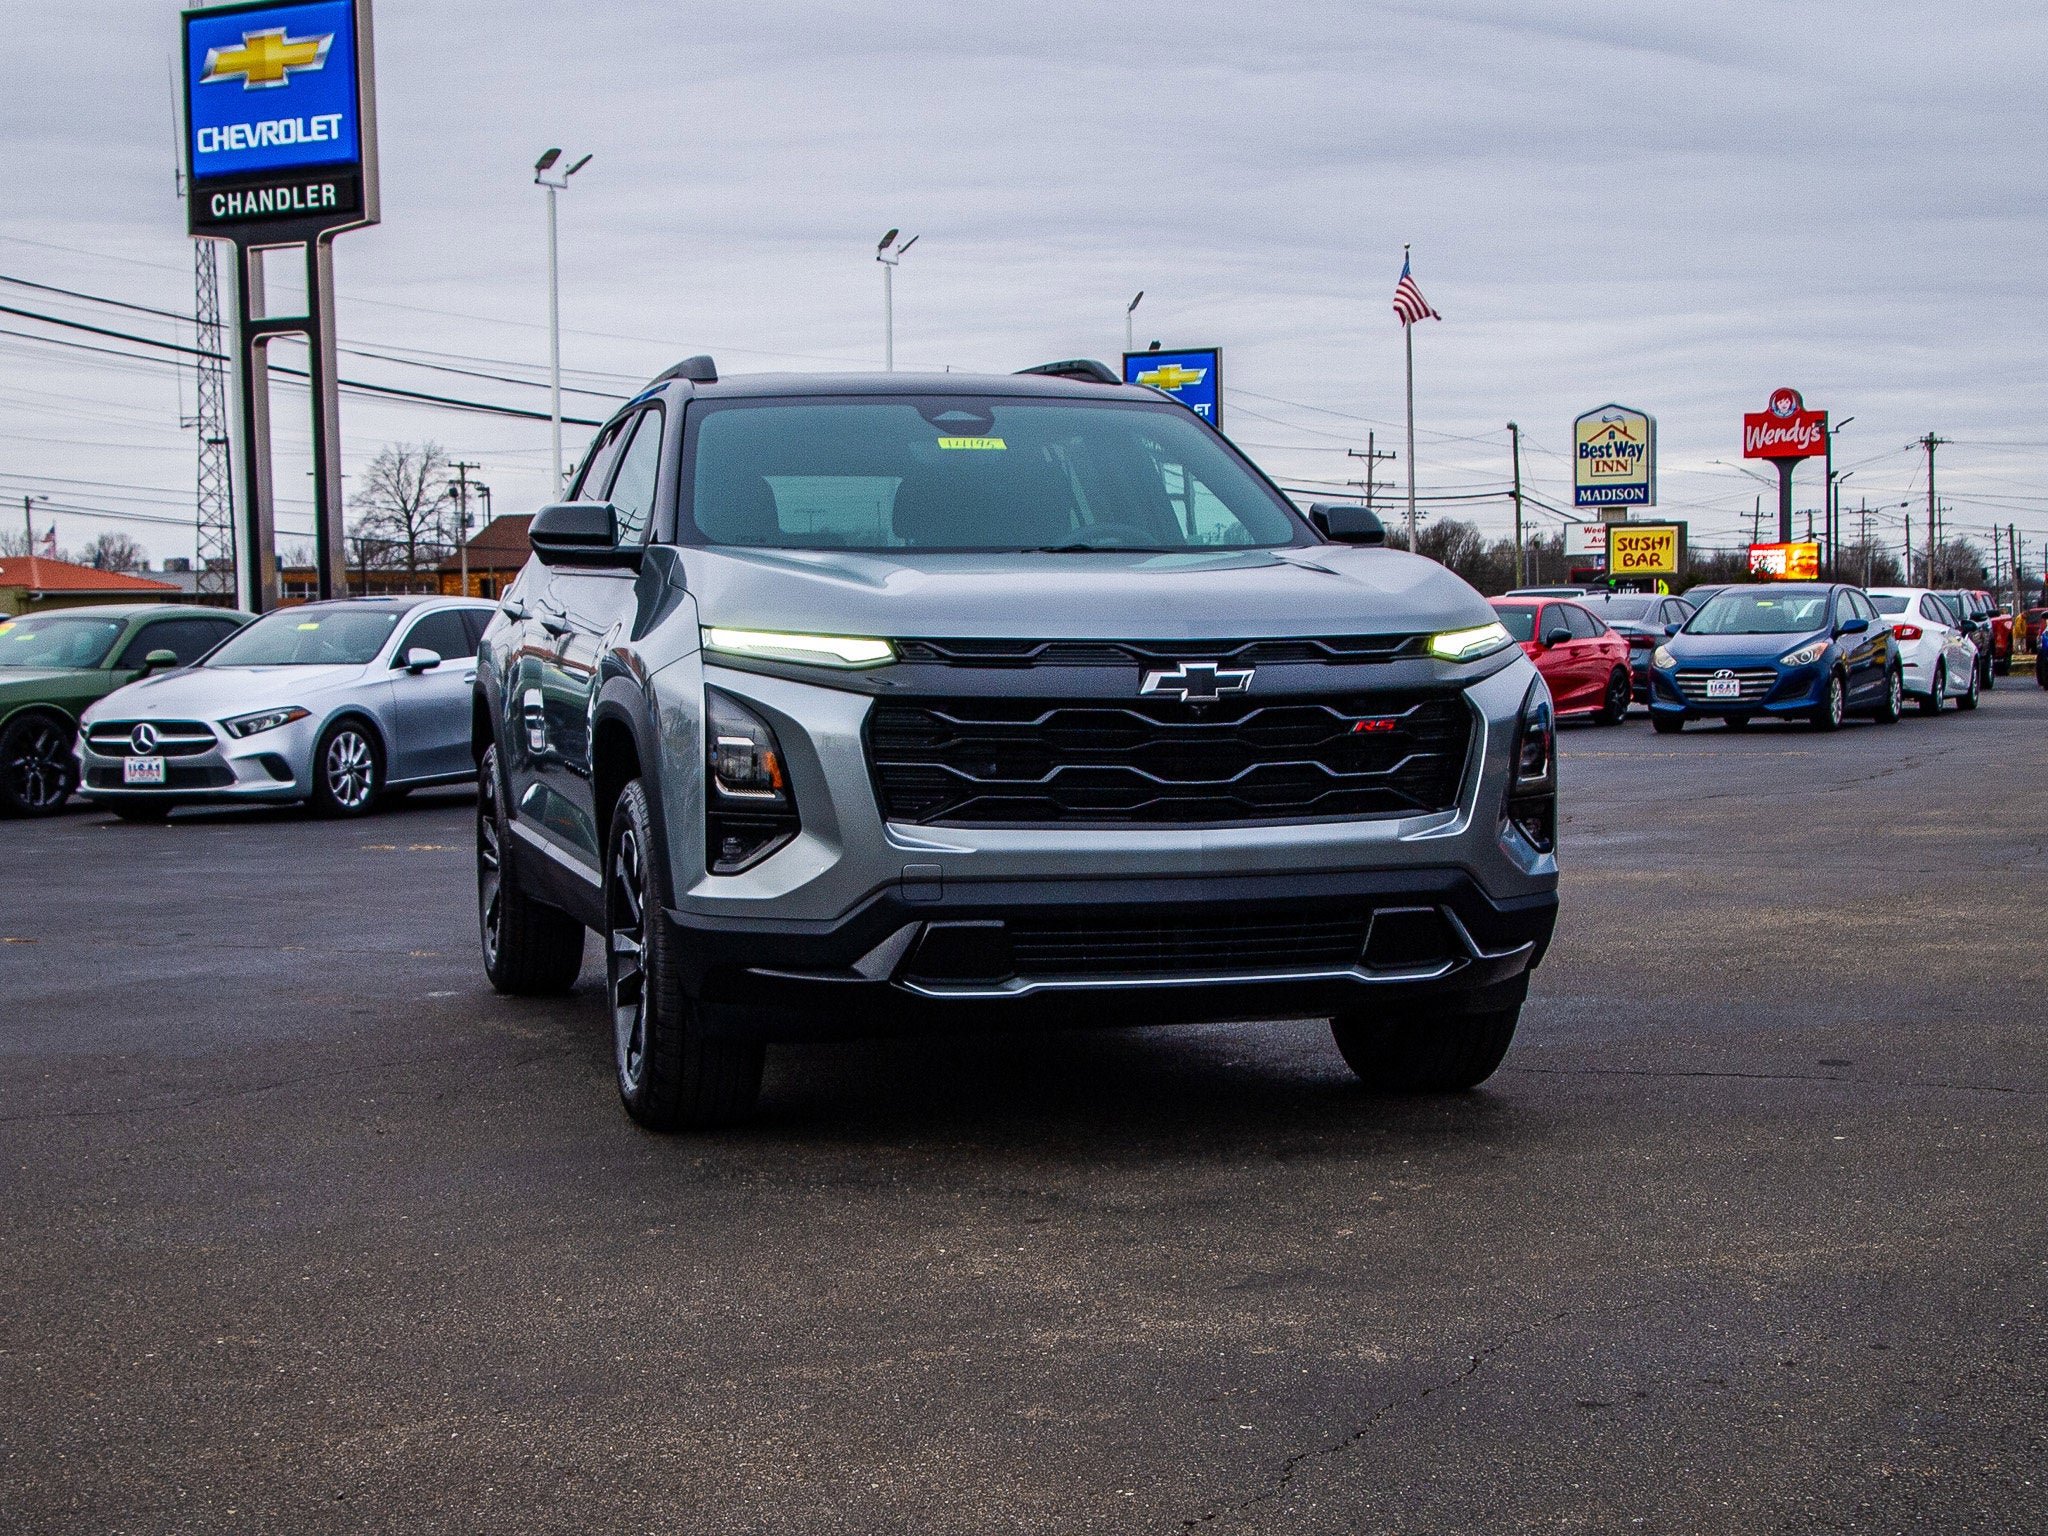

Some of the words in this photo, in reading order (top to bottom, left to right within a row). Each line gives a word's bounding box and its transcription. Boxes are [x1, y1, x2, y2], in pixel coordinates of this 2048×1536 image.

[197, 114, 343, 153] CHEVROLET
[211, 183, 336, 217] CHANDLER
[1746, 417, 1821, 452] Wendy's
[1579, 441, 1612, 459] Best
[1613, 440, 1645, 463] Way
[1594, 459, 1629, 473] INN
[1580, 487, 1645, 502] MADISON
[1617, 536, 1671, 552] SUSHI
[1623, 552, 1663, 567] BAR
[1354, 719, 1396, 733] RS
